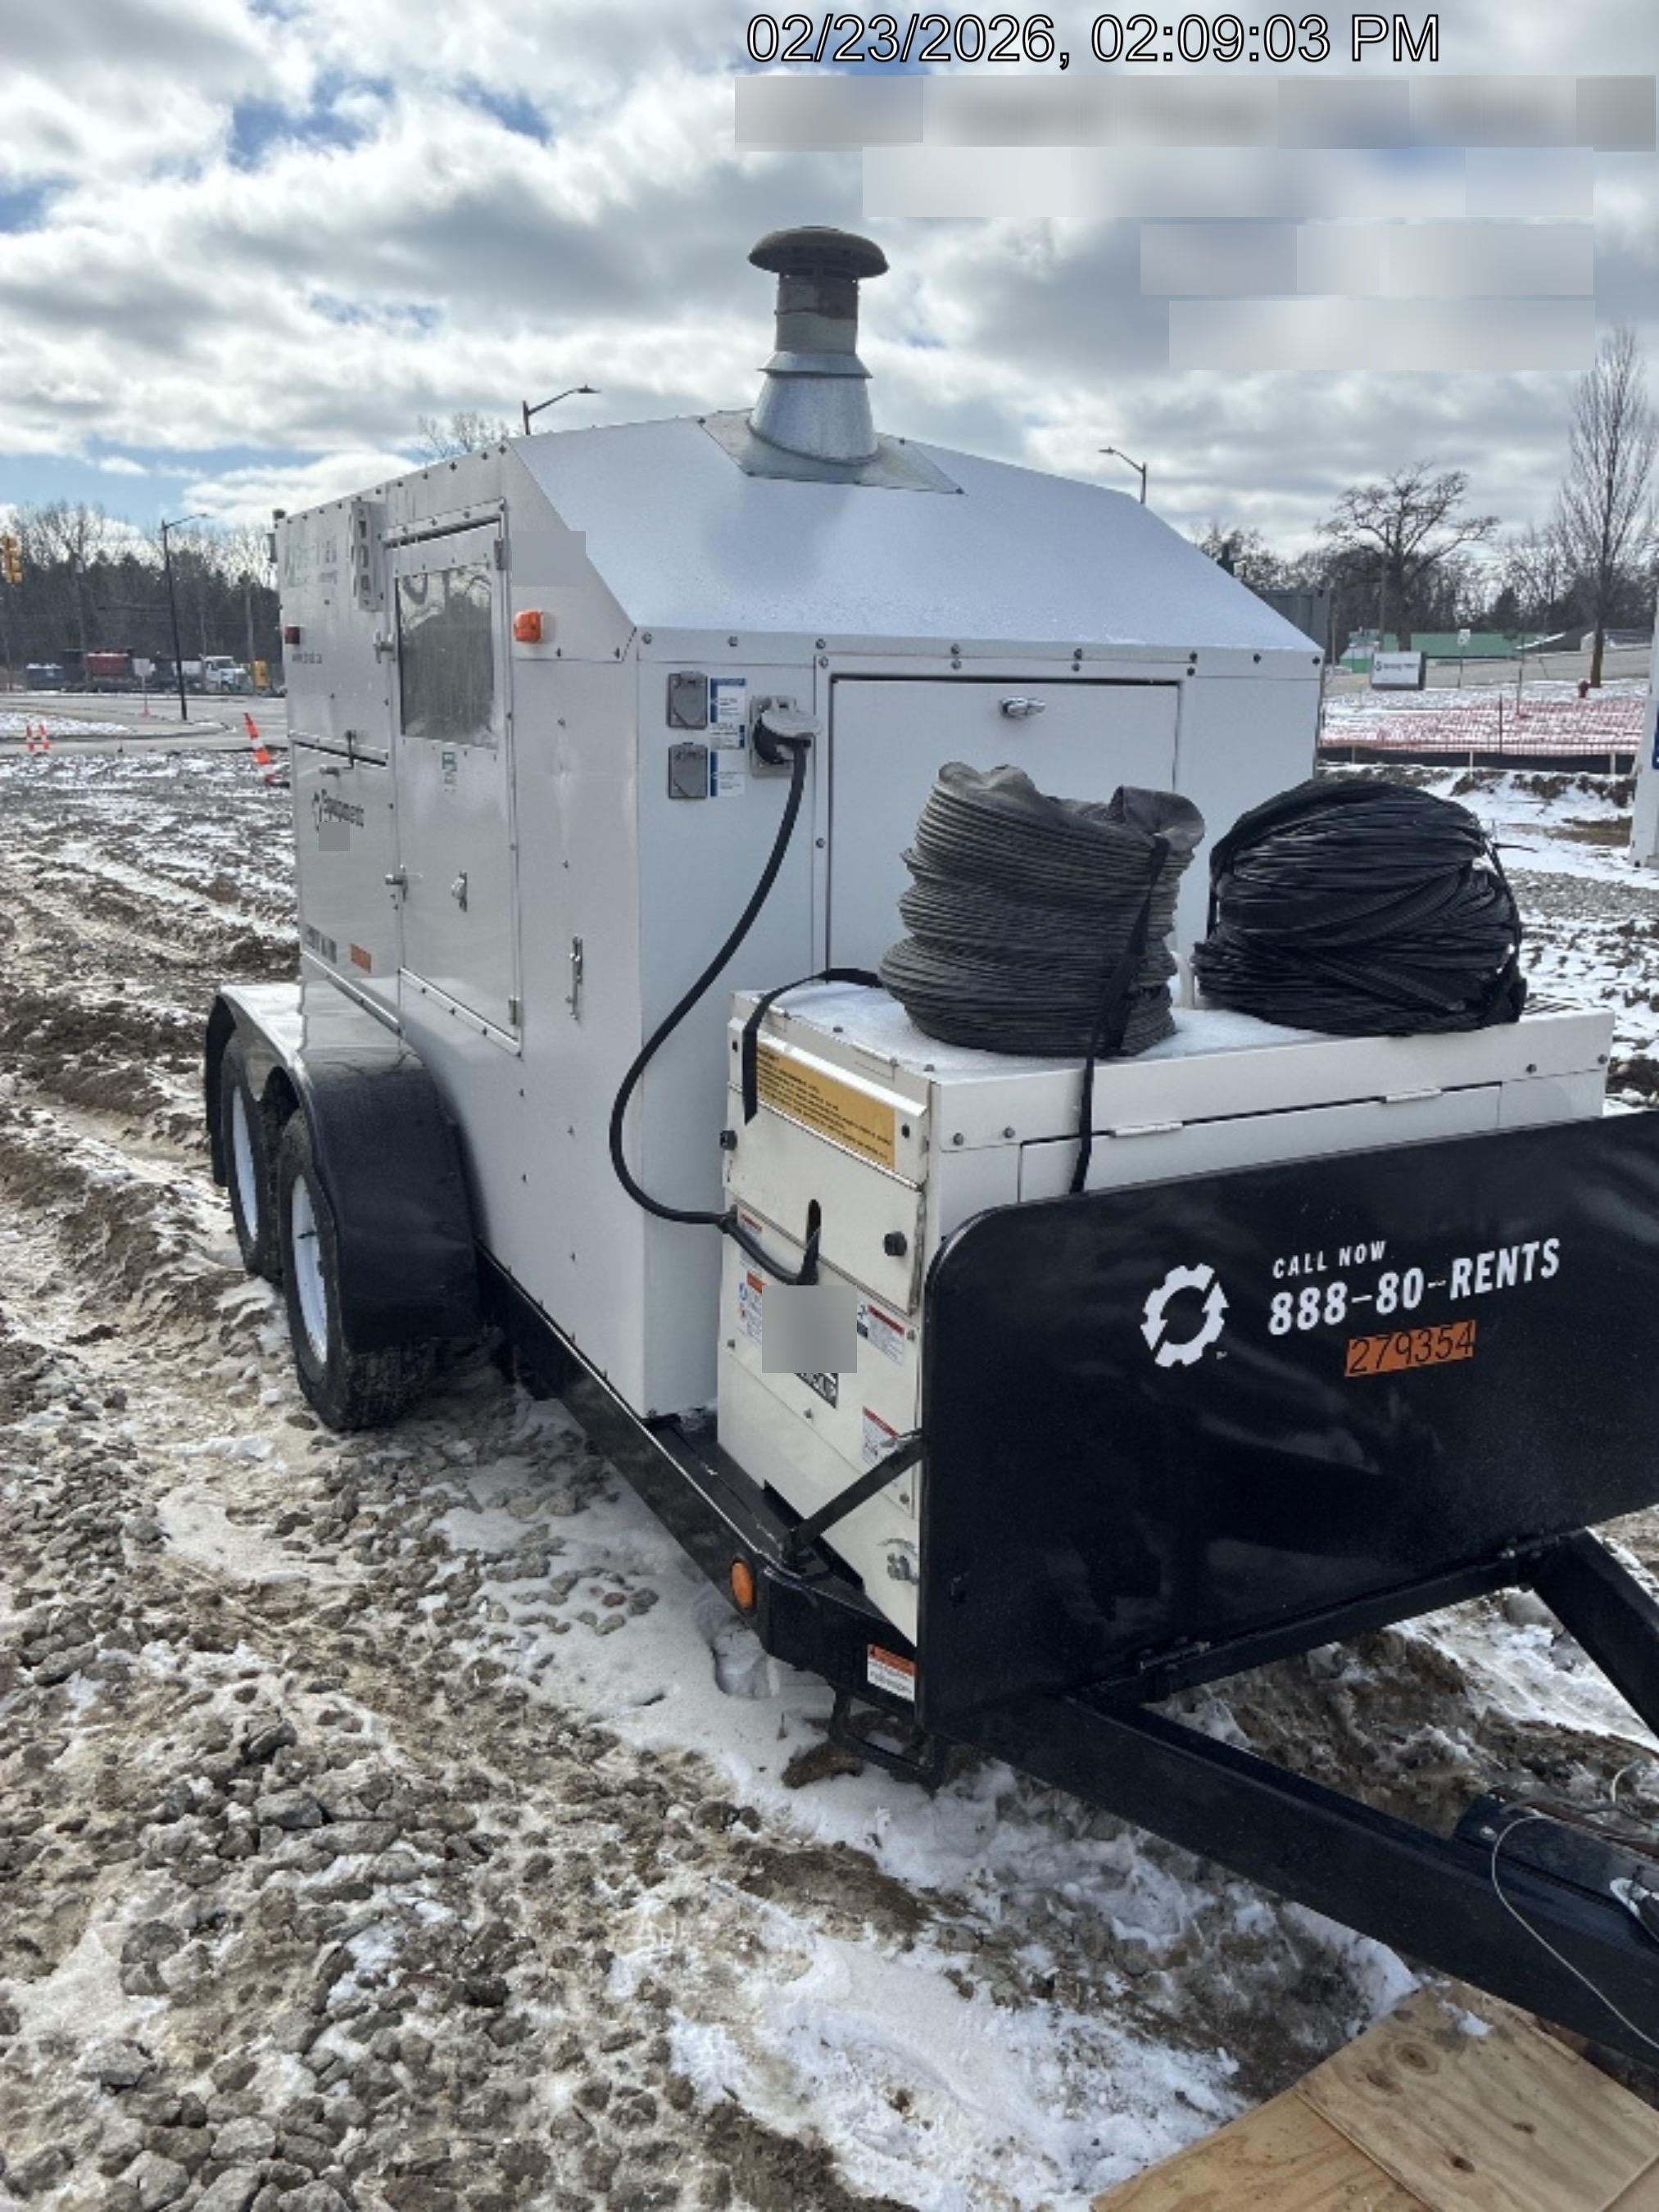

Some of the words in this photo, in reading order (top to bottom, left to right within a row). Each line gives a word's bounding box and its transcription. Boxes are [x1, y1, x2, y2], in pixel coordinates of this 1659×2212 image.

[1273, 1251, 1326, 1278] CALL
[1339, 1241, 1385, 1266] NOW
[1269, 1239, 1559, 1335] 888-80-RENTS
[1349, 1321, 1473, 1373] 279354
